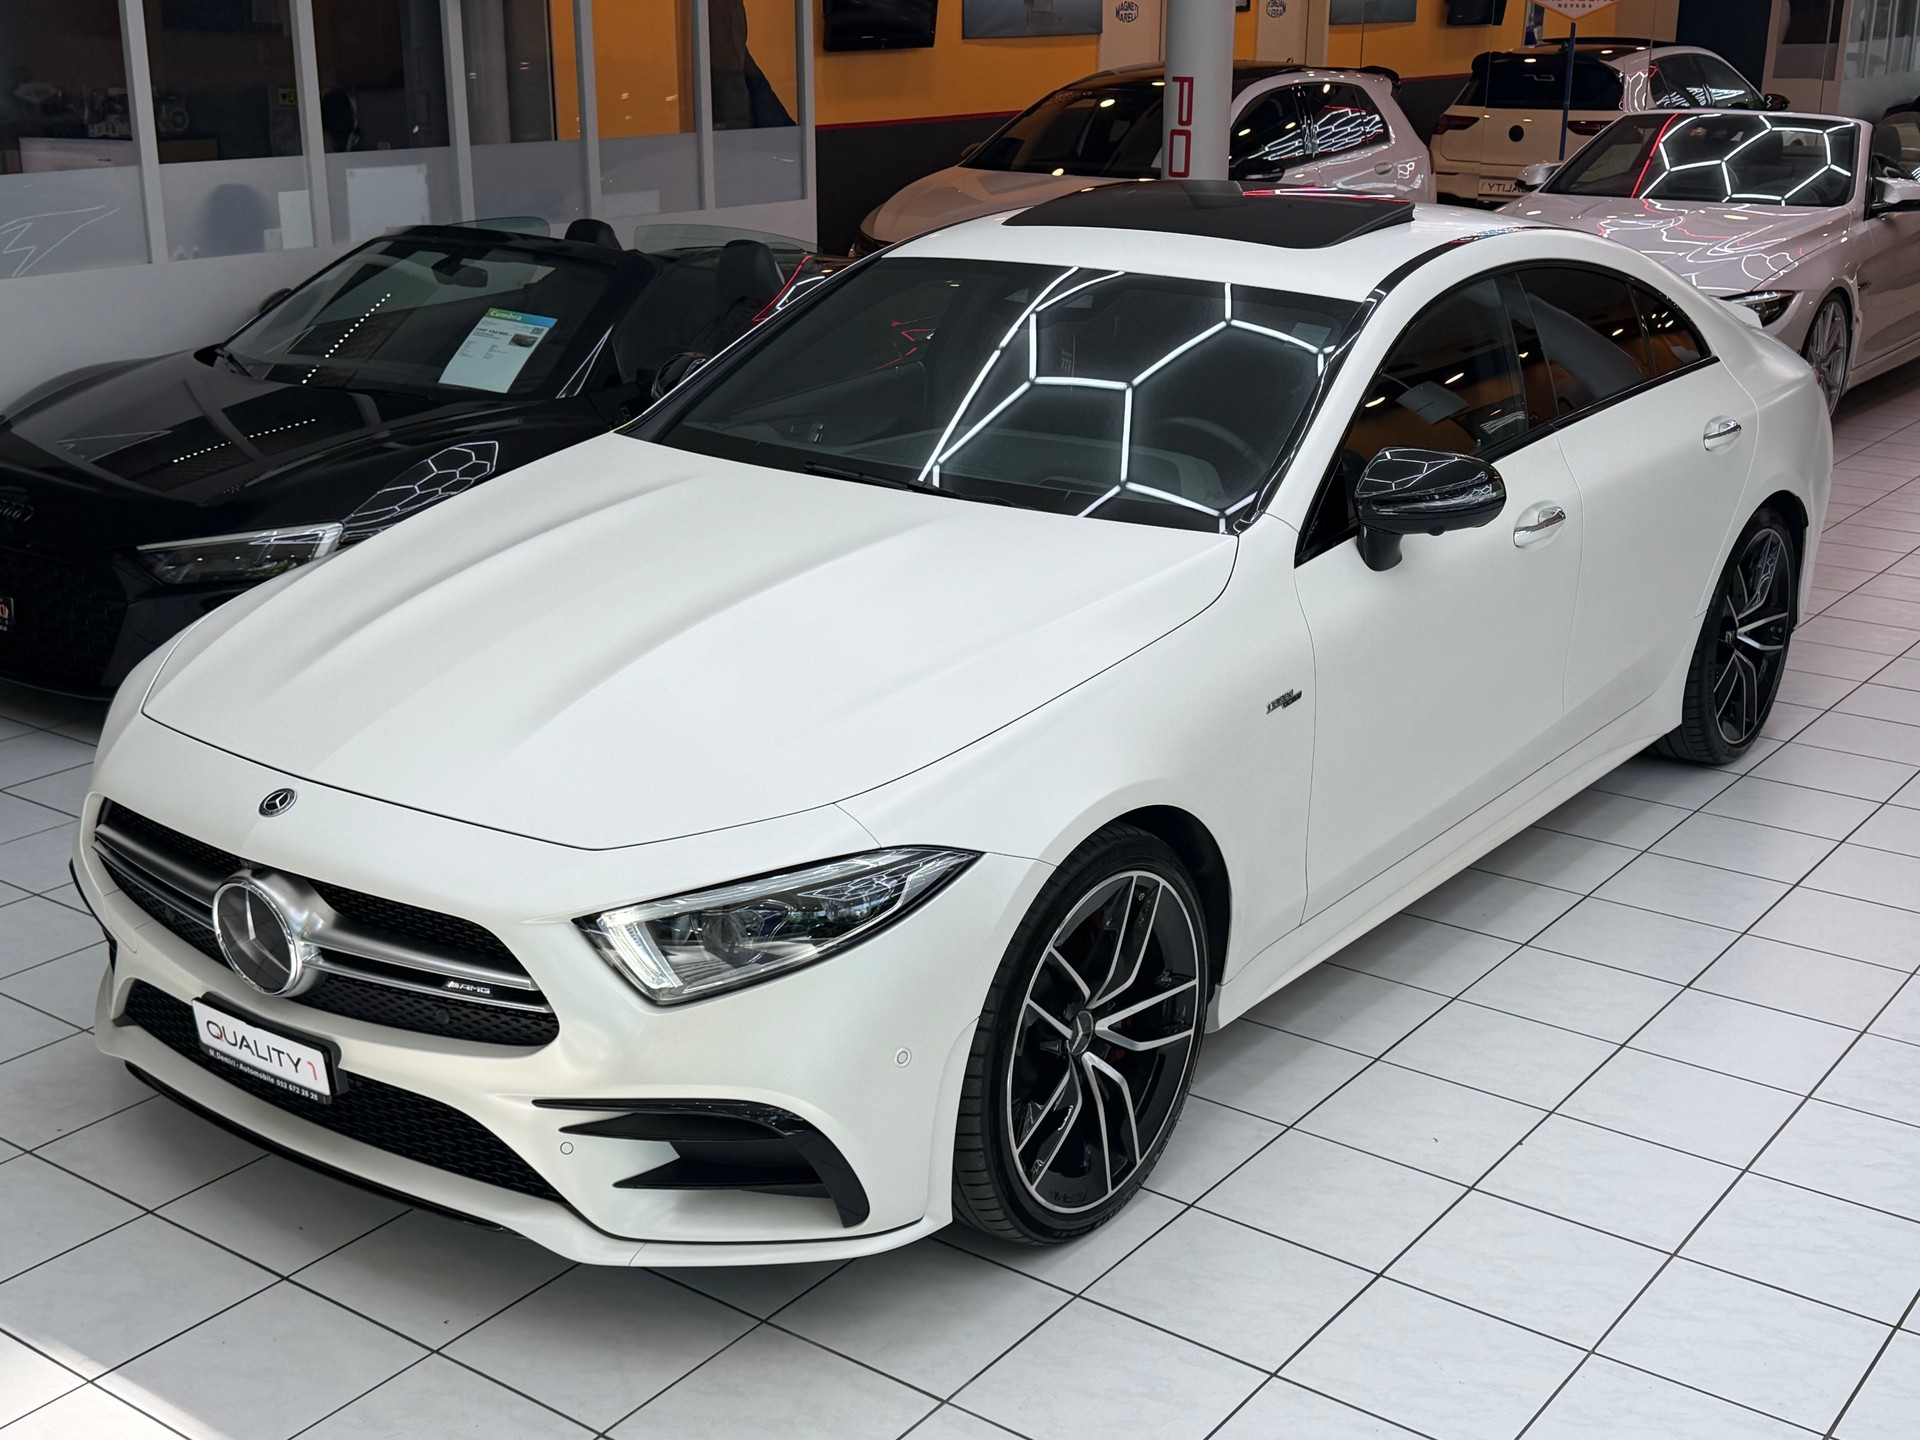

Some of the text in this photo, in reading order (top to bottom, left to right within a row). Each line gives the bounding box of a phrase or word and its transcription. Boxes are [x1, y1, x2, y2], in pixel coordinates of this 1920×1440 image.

[490, 310, 522, 321] Cembra
[458, 982, 491, 995] AMG
[206, 1020, 302, 1074] QUALITY
[239, 1063, 275, 1084] Automobile
